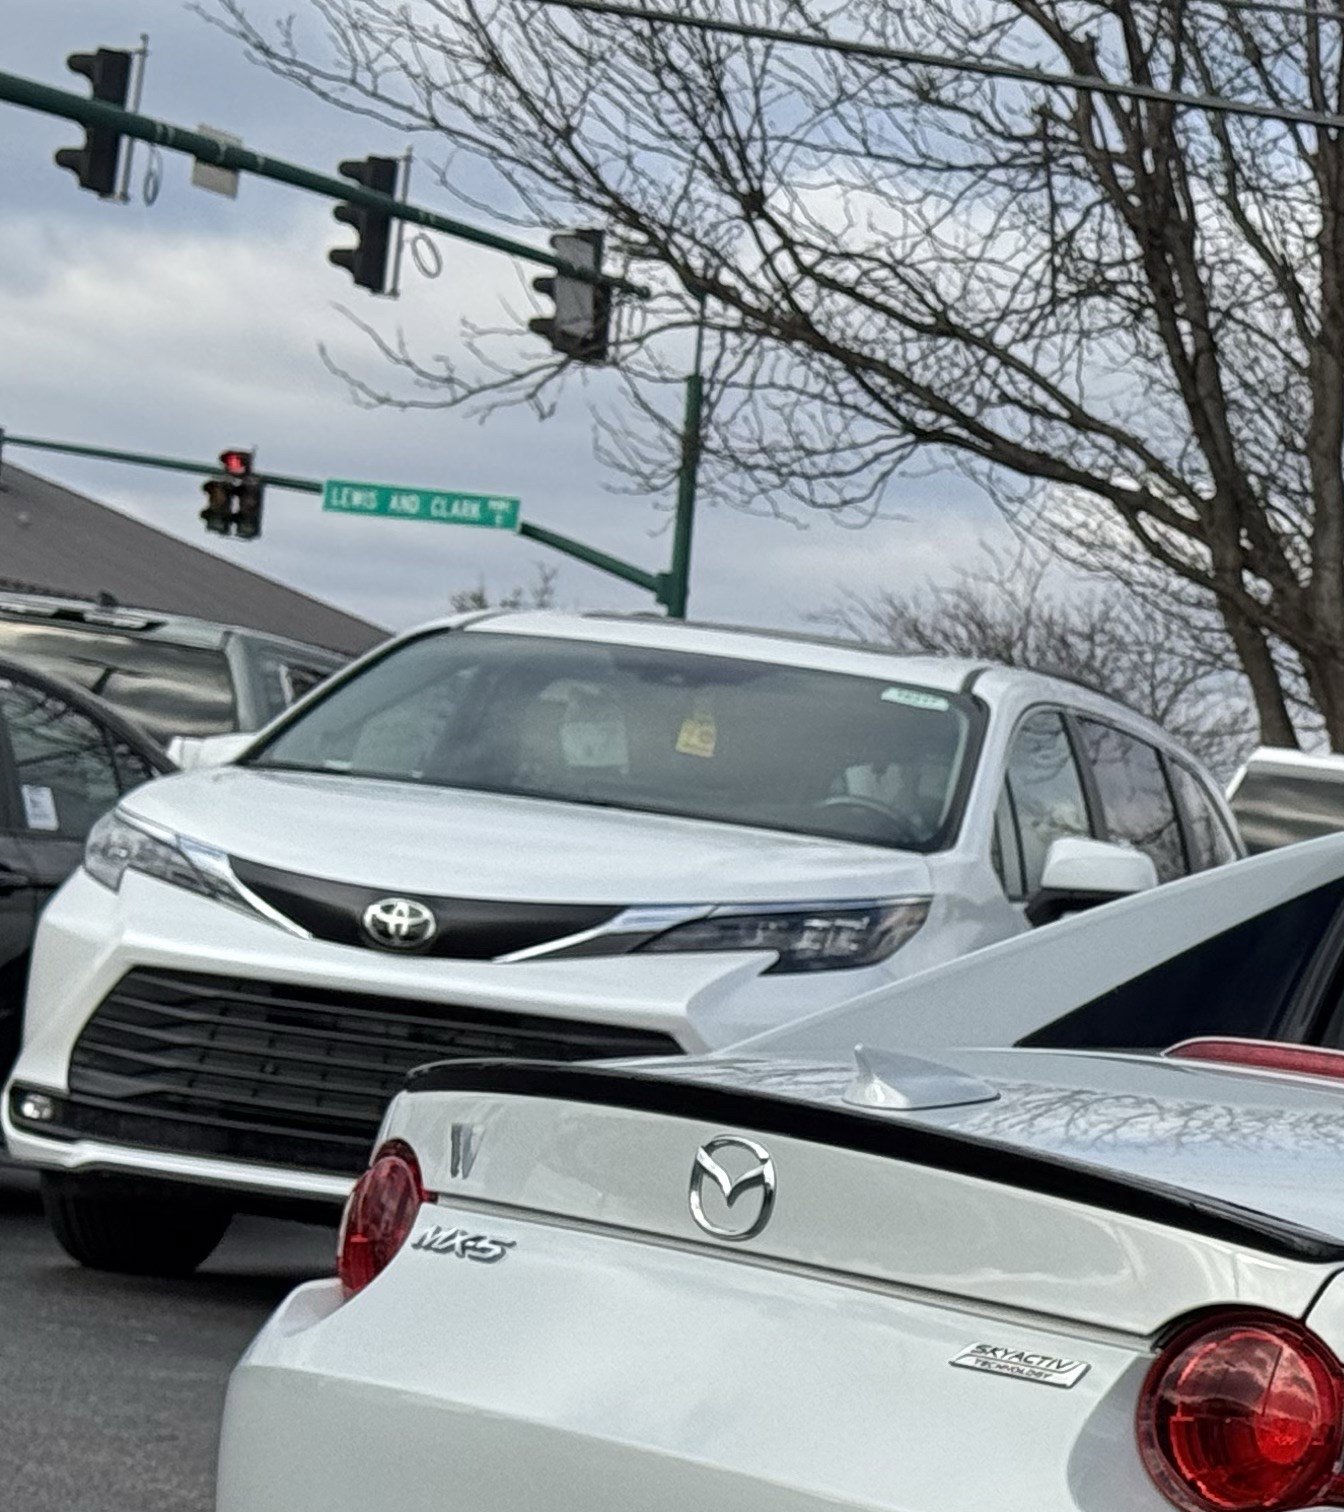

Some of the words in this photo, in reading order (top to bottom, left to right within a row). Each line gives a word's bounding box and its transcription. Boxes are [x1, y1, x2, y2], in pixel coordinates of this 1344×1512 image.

[331, 486, 378, 511] LEWIS
[387, 493, 421, 516] AND
[430, 496, 482, 522] CLARK
[970, 1343, 1076, 1370] SKYACTIV
